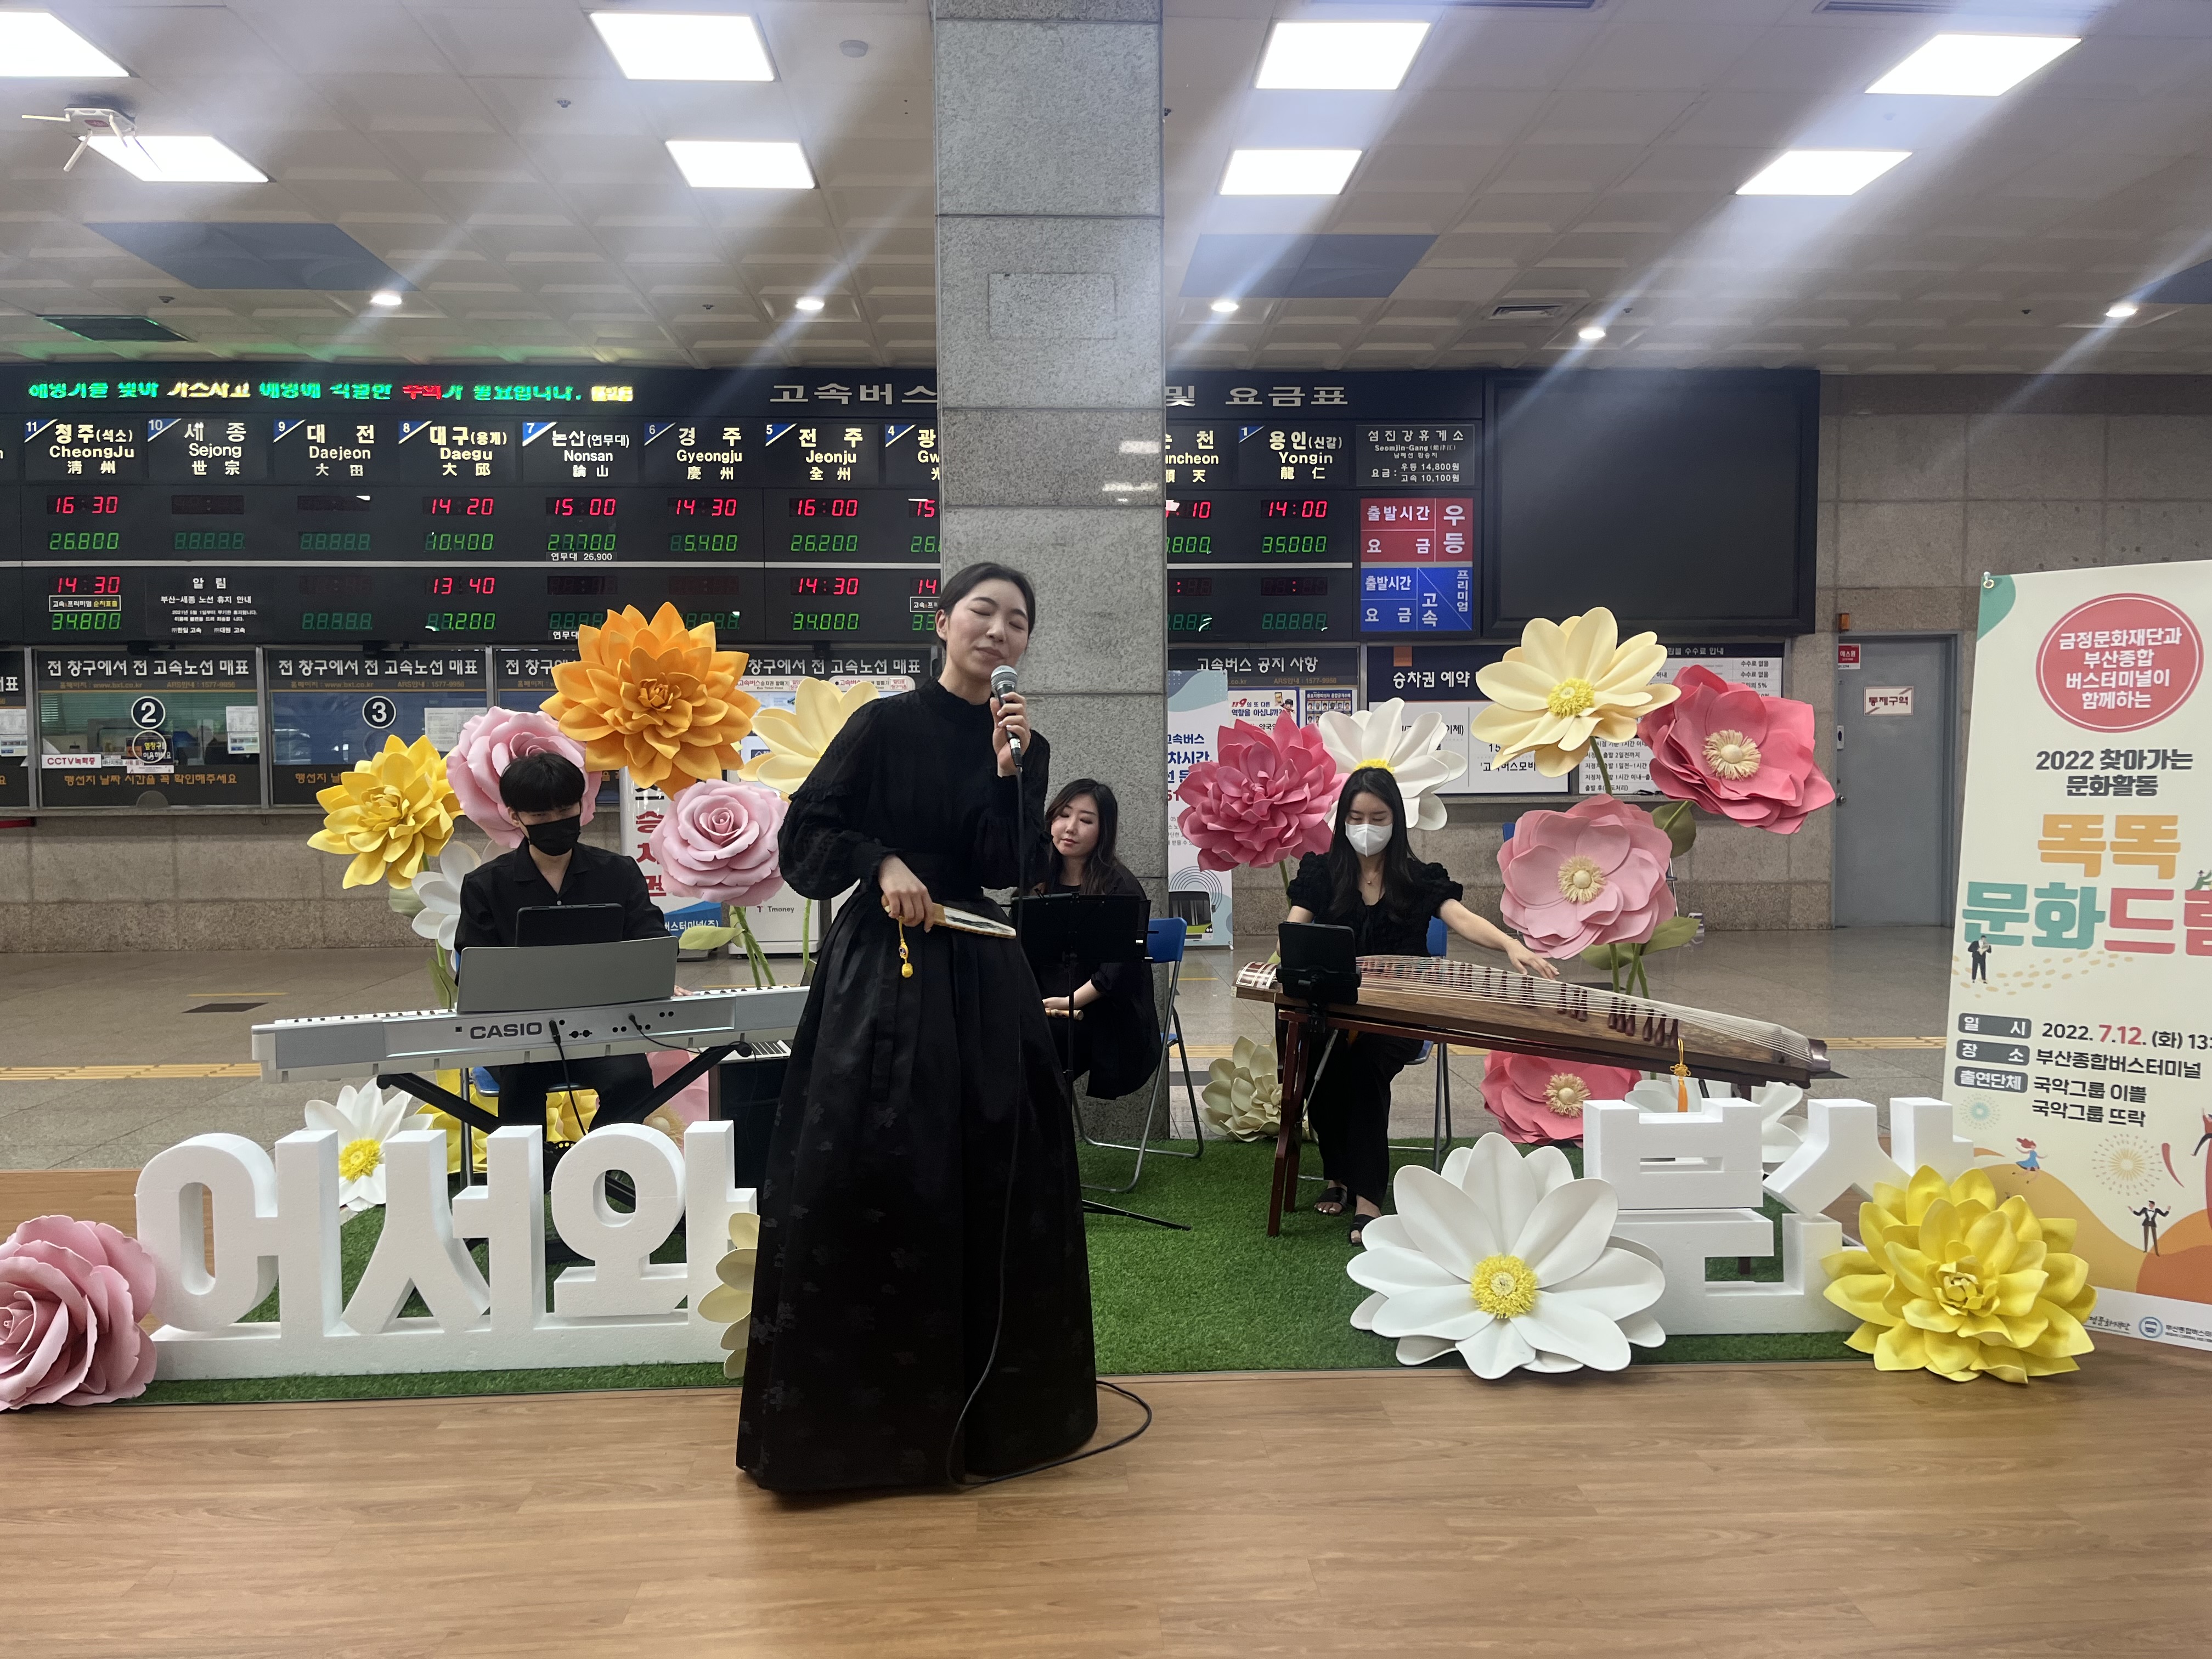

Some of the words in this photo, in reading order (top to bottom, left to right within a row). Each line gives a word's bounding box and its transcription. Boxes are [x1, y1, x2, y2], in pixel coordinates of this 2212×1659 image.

[770, 383, 938, 405] 고속버스
[1165, 385, 1195, 407] 및
[1225, 386, 1348, 407] 요금표
[26, 421, 37, 432] 11
[149, 419, 162, 431] 10
[278, 421, 285, 432] 9
[403, 422, 410, 433] 8
[527, 422, 535, 434] 7
[648, 425, 656, 435] 6
[766, 425, 773, 435] 5
[888, 425, 895, 436] 4
[1241, 427, 1248, 436] 1
[49, 445, 134, 459] CheongJu
[188, 443, 242, 460] Sejong
[309, 445, 371, 461] Daejeon
[440, 448, 493, 462] Daegu
[564, 450, 613, 462] Nonsan
[676, 449, 743, 465] Gyeongju
[805, 450, 856, 465] Jeonju
[1278, 452, 1333, 466] Yongin
[1421, 463, 1459, 471] 14,800원
[1421, 475, 1459, 483] 10,100원
[1367, 506, 1430, 521] 출발시간
[551, 553, 577, 561] 연무대
[1365, 575, 1411, 591] 출발시간
[1457, 570, 1469, 612] 프리미엄
[1421, 593, 1438, 627] 고속
[2059, 627, 2182, 651] 금정문화재단과
[1197, 657, 1252, 673] 고속버스
[1257, 657, 1284, 673] 공지
[1290, 657, 1318, 673] 사항
[2083, 648, 2154, 669] 부산종합
[48, 660, 61, 676] 전
[67, 659, 127, 677] 창구에서
[133, 660, 147, 676] 전
[154, 659, 213, 676] 고속노선
[220, 659, 249, 675] 매표
[279, 659, 292, 675] 전
[298, 659, 358, 676] 창구에서
[365, 659, 378, 675] 전
[385, 659, 443, 675] 고속노선
[449, 659, 478, 675] 매표
[506, 659, 519, 675] 전
[748, 659, 805, 675] 창구에서
[812, 659, 825, 675] 전
[831, 659, 887, 675] 고속노선
[893, 659, 921, 674] 매표
[1393, 671, 1435, 689] 승차권
[1441, 671, 1470, 687] 예약
[2066, 668, 2170, 690] 버스터미널이
[1869, 696, 1908, 706] 통제구역
[2081, 690, 2152, 710] 함께하는
[141, 702, 156, 723] 2
[372, 702, 387, 723] 3
[2036, 751, 2094, 771] 2022
[2100, 748, 2193, 771] 찾아가는
[64, 775, 95, 786] 행선지
[100, 775, 121, 786] 날짜
[125, 774, 155, 785] 시간을
[160, 775, 170, 785] 꼭
[174, 774, 237, 785] 확인해주세요
[295, 773, 326, 784] 행선지
[2066, 774, 2159, 797] 문화활동
[2038, 814, 2181, 880] 똑똑
[470, 1022, 543, 1040] CASIO
[2152, 1030, 2183, 1050] (화)
[2036, 1048, 2202, 1079] 부산종합버스터미널
[1960, 1069, 2022, 1091] 출연단체
[2033, 1075, 2106, 1099] 국악그룹
[2032, 1099, 2104, 1124] 국악그룹
[2108, 1108, 2146, 1127] 뜨락
